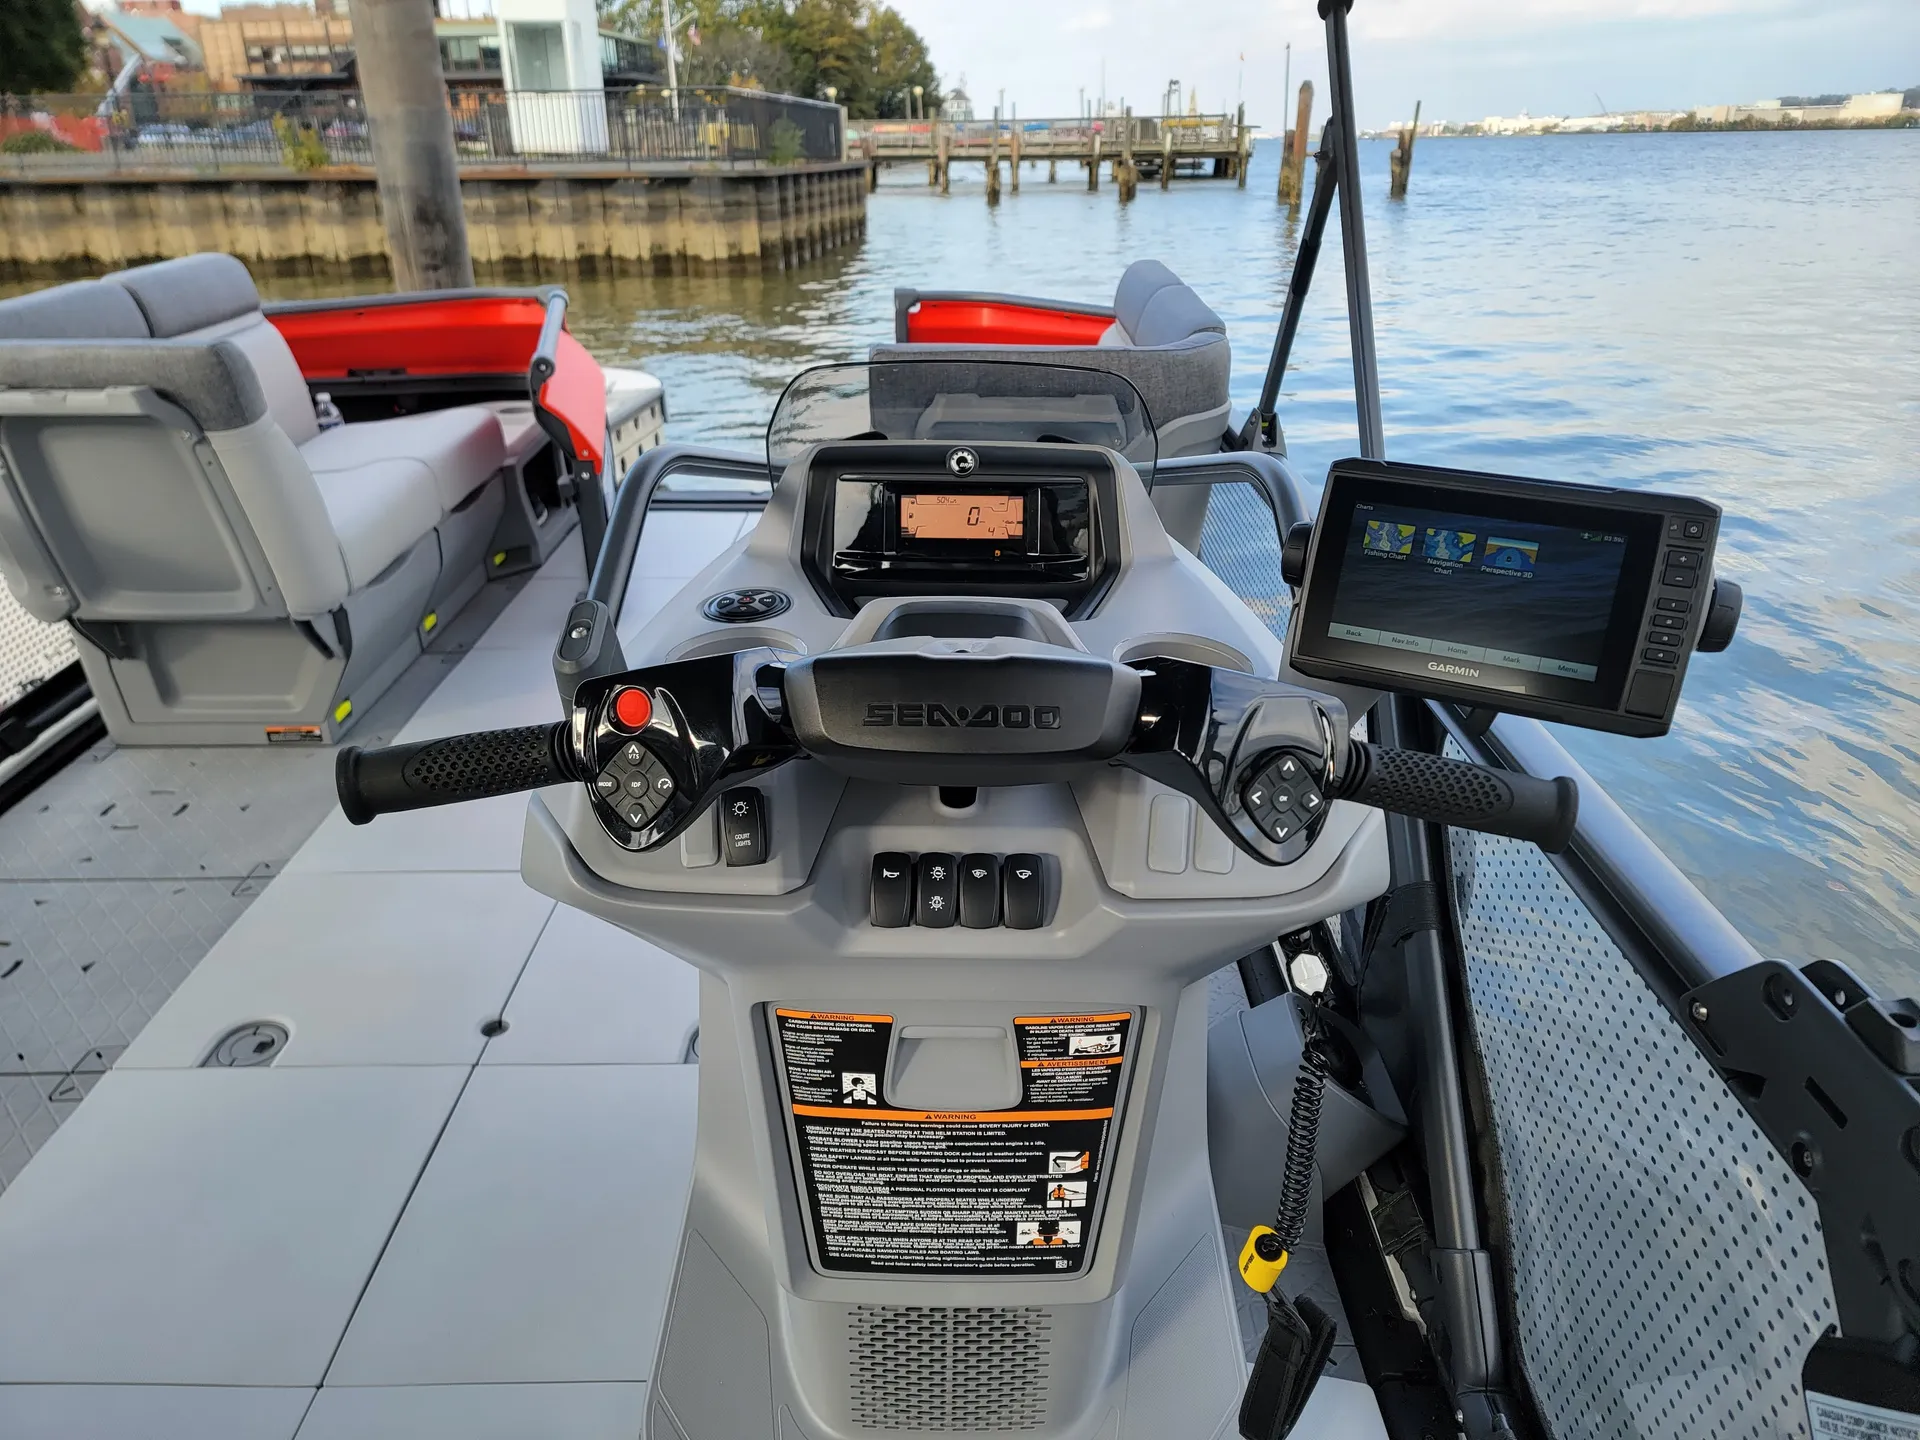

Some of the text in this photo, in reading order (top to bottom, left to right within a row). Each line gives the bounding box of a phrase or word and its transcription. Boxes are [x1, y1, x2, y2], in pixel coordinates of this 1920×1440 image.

[967, 506, 980, 526] 0
[1363, 549, 1407, 560] Fishing Chart
[1427, 558, 1463, 568] Navigation
[1433, 567, 1452, 575] Chart
[1480, 565, 1533, 579] Perspective 3D
[1345, 629, 1362, 637] Back
[1447, 646, 1468, 655] Home
[1503, 655, 1521, 664] Mark
[1427, 661, 1480, 678] GARMIN
[1558, 665, 1579, 673] Menu
[734, 832, 750, 840] COURT
[817, 1013, 855, 1021] WARNING
